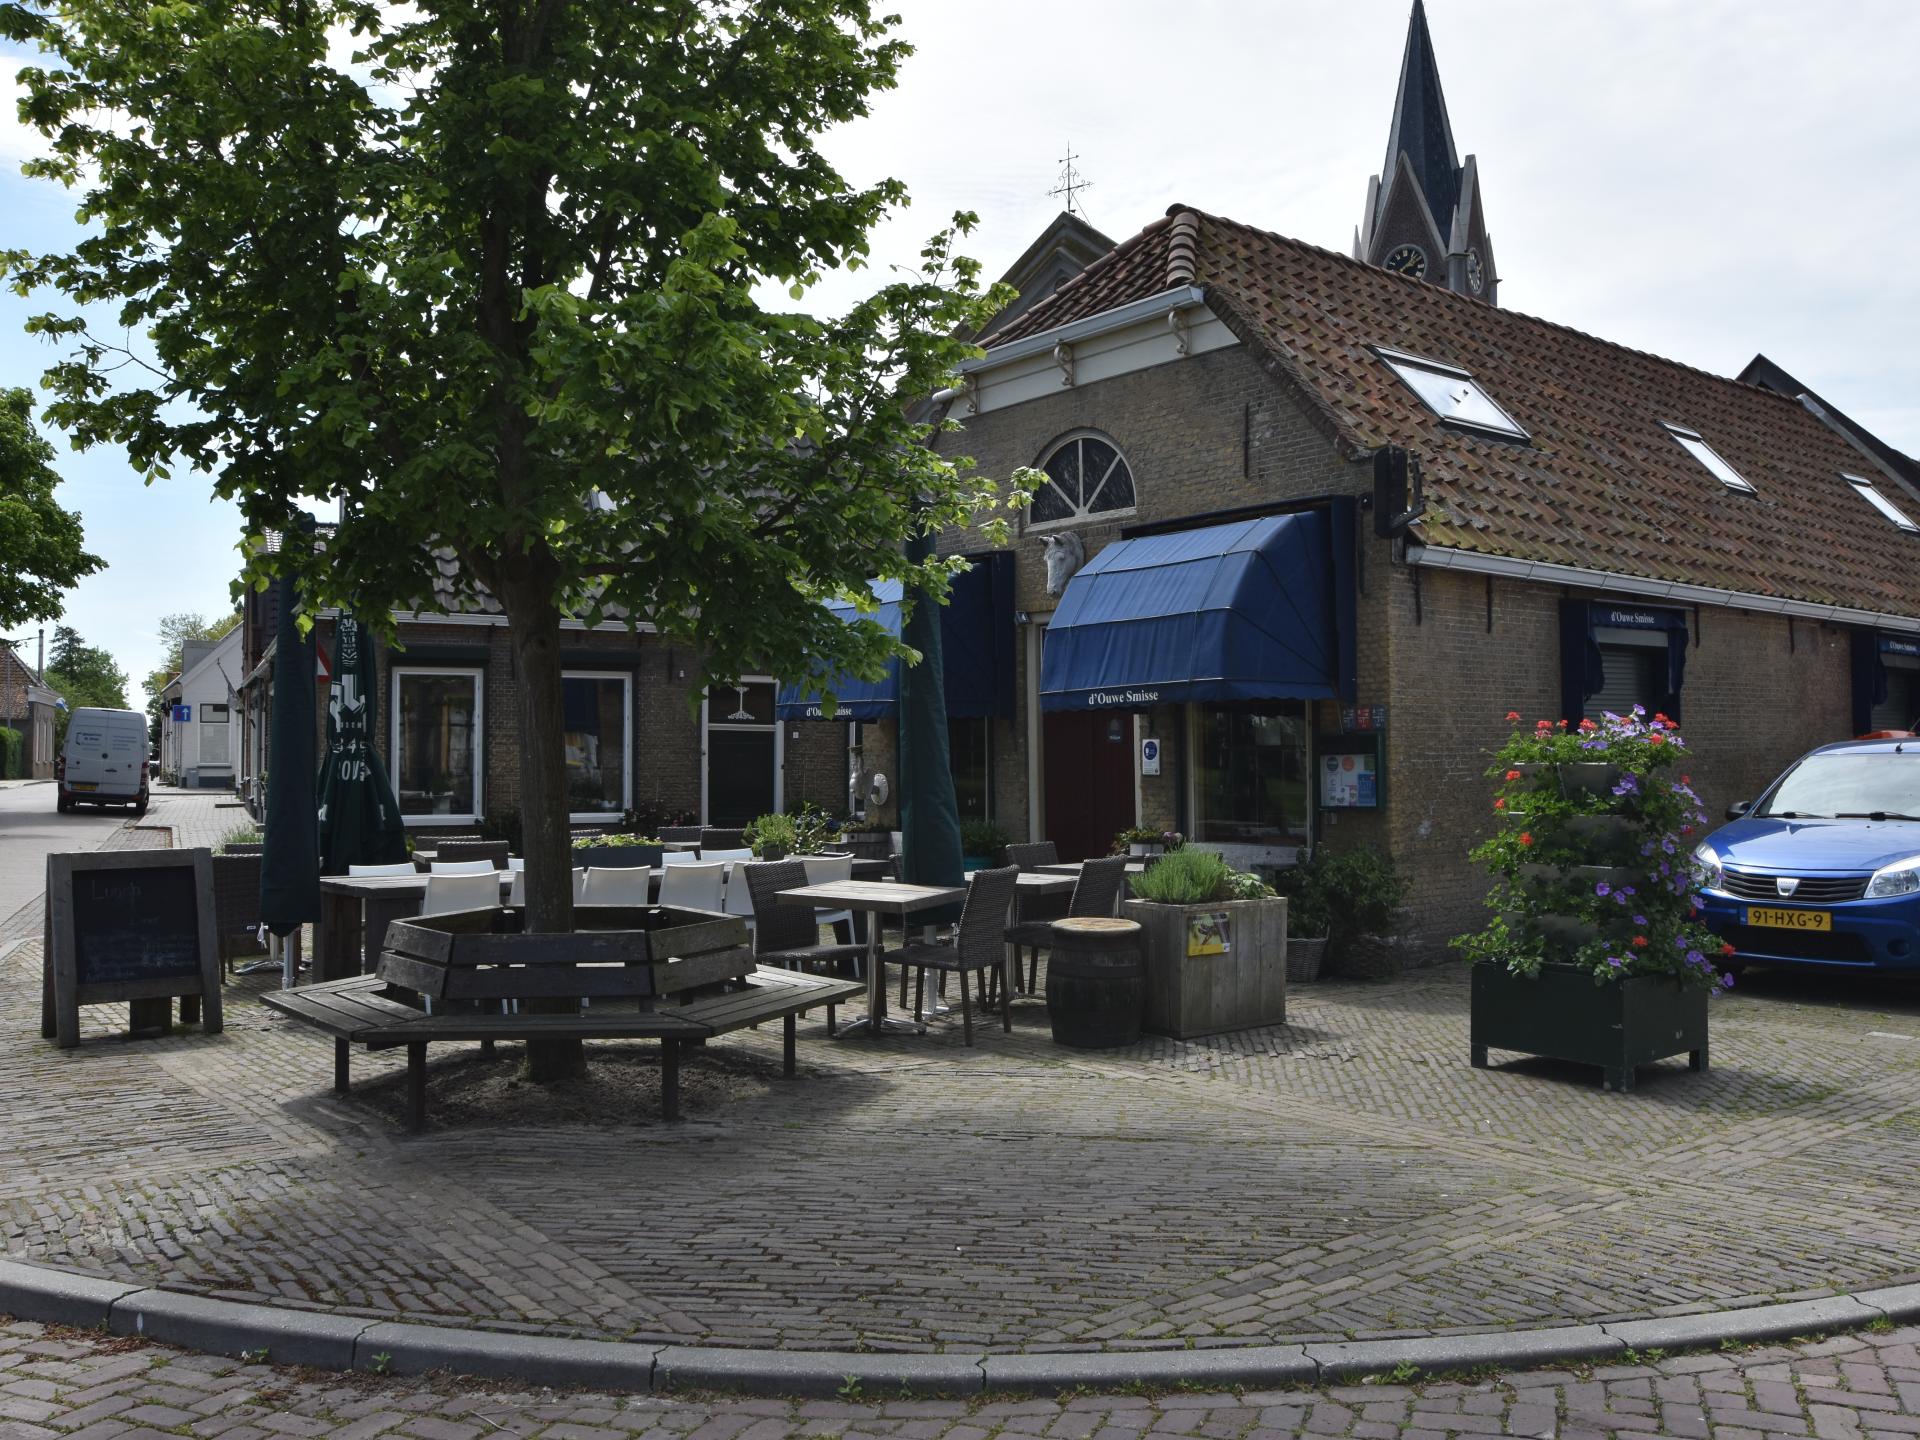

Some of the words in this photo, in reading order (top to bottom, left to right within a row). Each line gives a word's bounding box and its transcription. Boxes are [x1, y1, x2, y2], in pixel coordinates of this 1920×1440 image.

[1088, 692, 1124, 705] d'Ouwe
[1126, 689, 1159, 702] Smisse
[806, 706, 824, 717] d'Ou
[1752, 910, 1824, 928] 91-HXG-9
